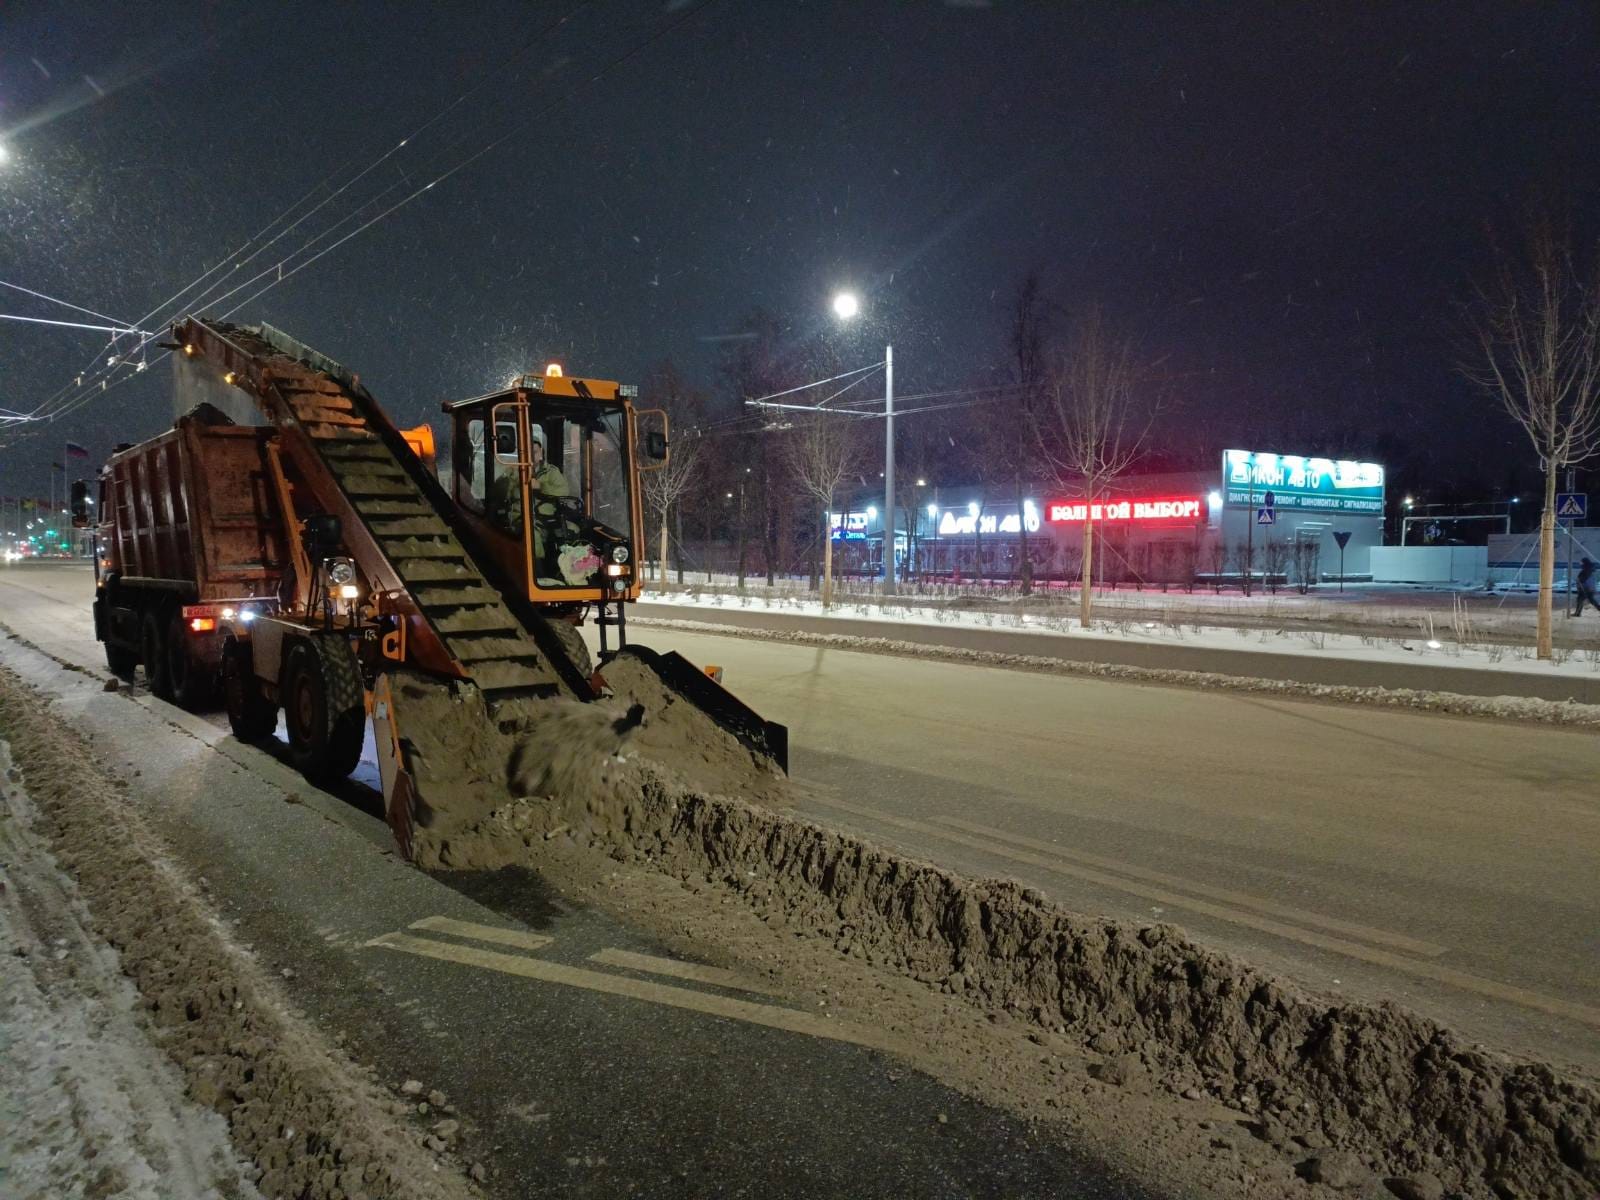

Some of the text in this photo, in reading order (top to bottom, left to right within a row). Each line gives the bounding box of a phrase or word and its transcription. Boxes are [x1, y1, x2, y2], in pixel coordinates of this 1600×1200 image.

[1274, 496, 1297, 505] РЕМОНТ
[1301, 497, 1340, 508] ШИНОМОНТАЖ
[1133, 501, 1200, 518] ВЫБОР!
